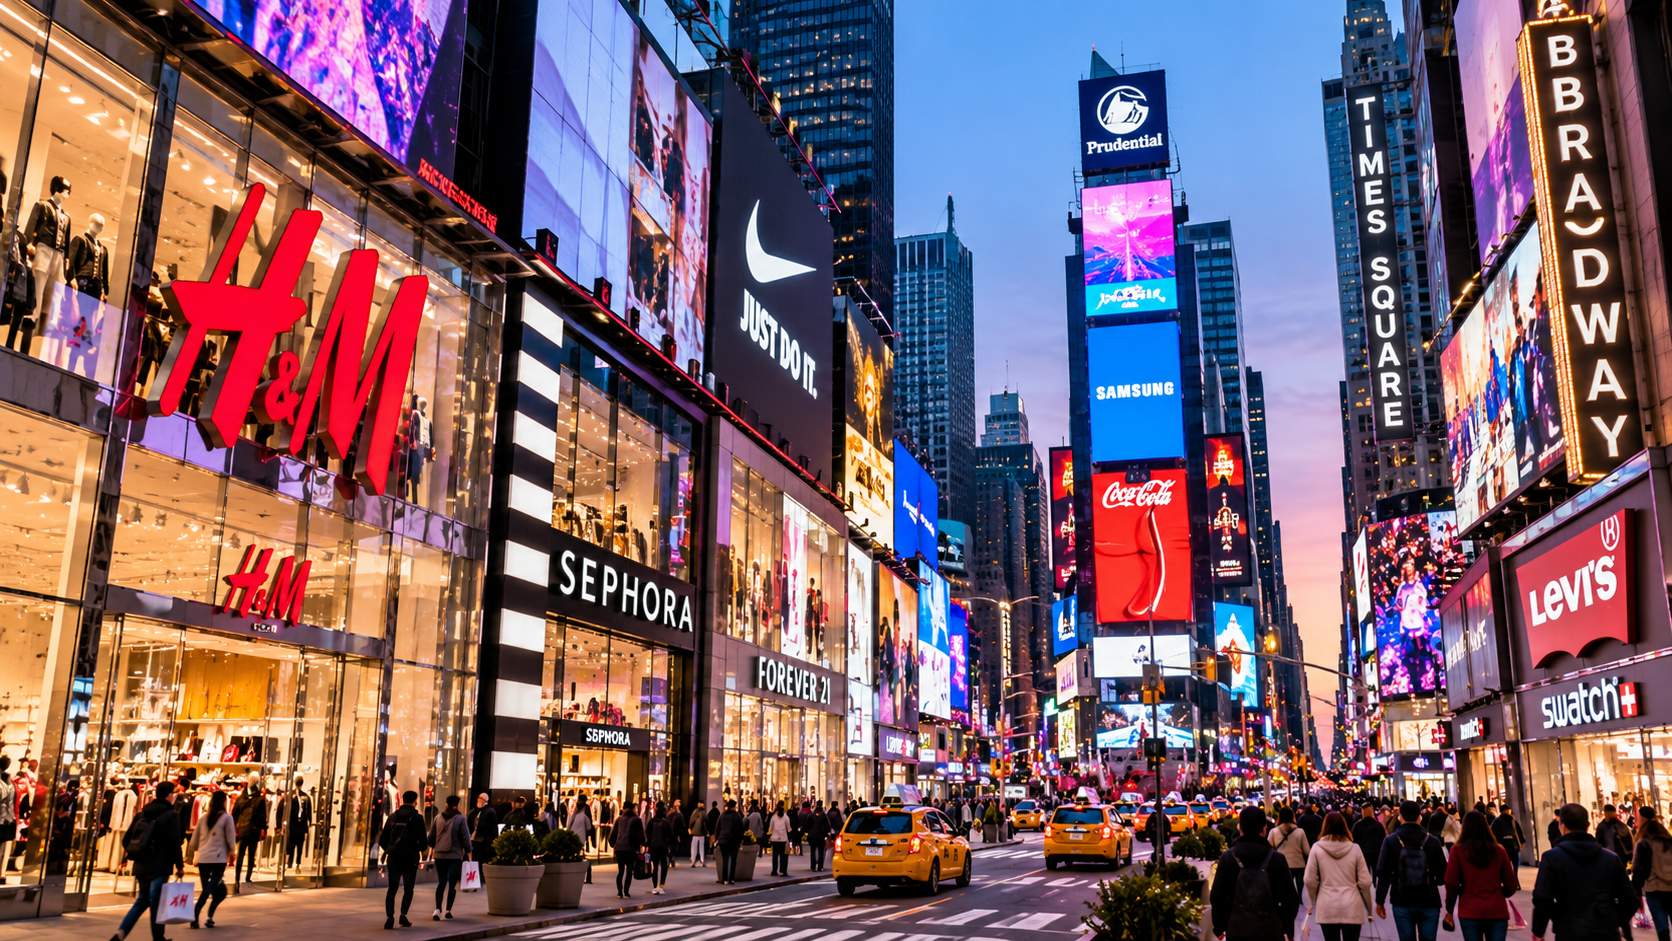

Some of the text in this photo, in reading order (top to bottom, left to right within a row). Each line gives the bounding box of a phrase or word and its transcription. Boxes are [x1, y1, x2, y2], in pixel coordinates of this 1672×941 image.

[1086, 132, 1163, 155] Prudential
[1355, 96, 1404, 427] TIMES SQUARE
[152, 182, 429, 496] H&M
[740, 287, 818, 400] JUST DO IT.
[1096, 381, 1174, 400] SAMSUNG
[1102, 479, 1176, 508] Coca-Cola
[222, 543, 312, 627] H&M
[560, 549, 693, 632] SEPHORA
[758, 655, 831, 705] FOREVER 21
